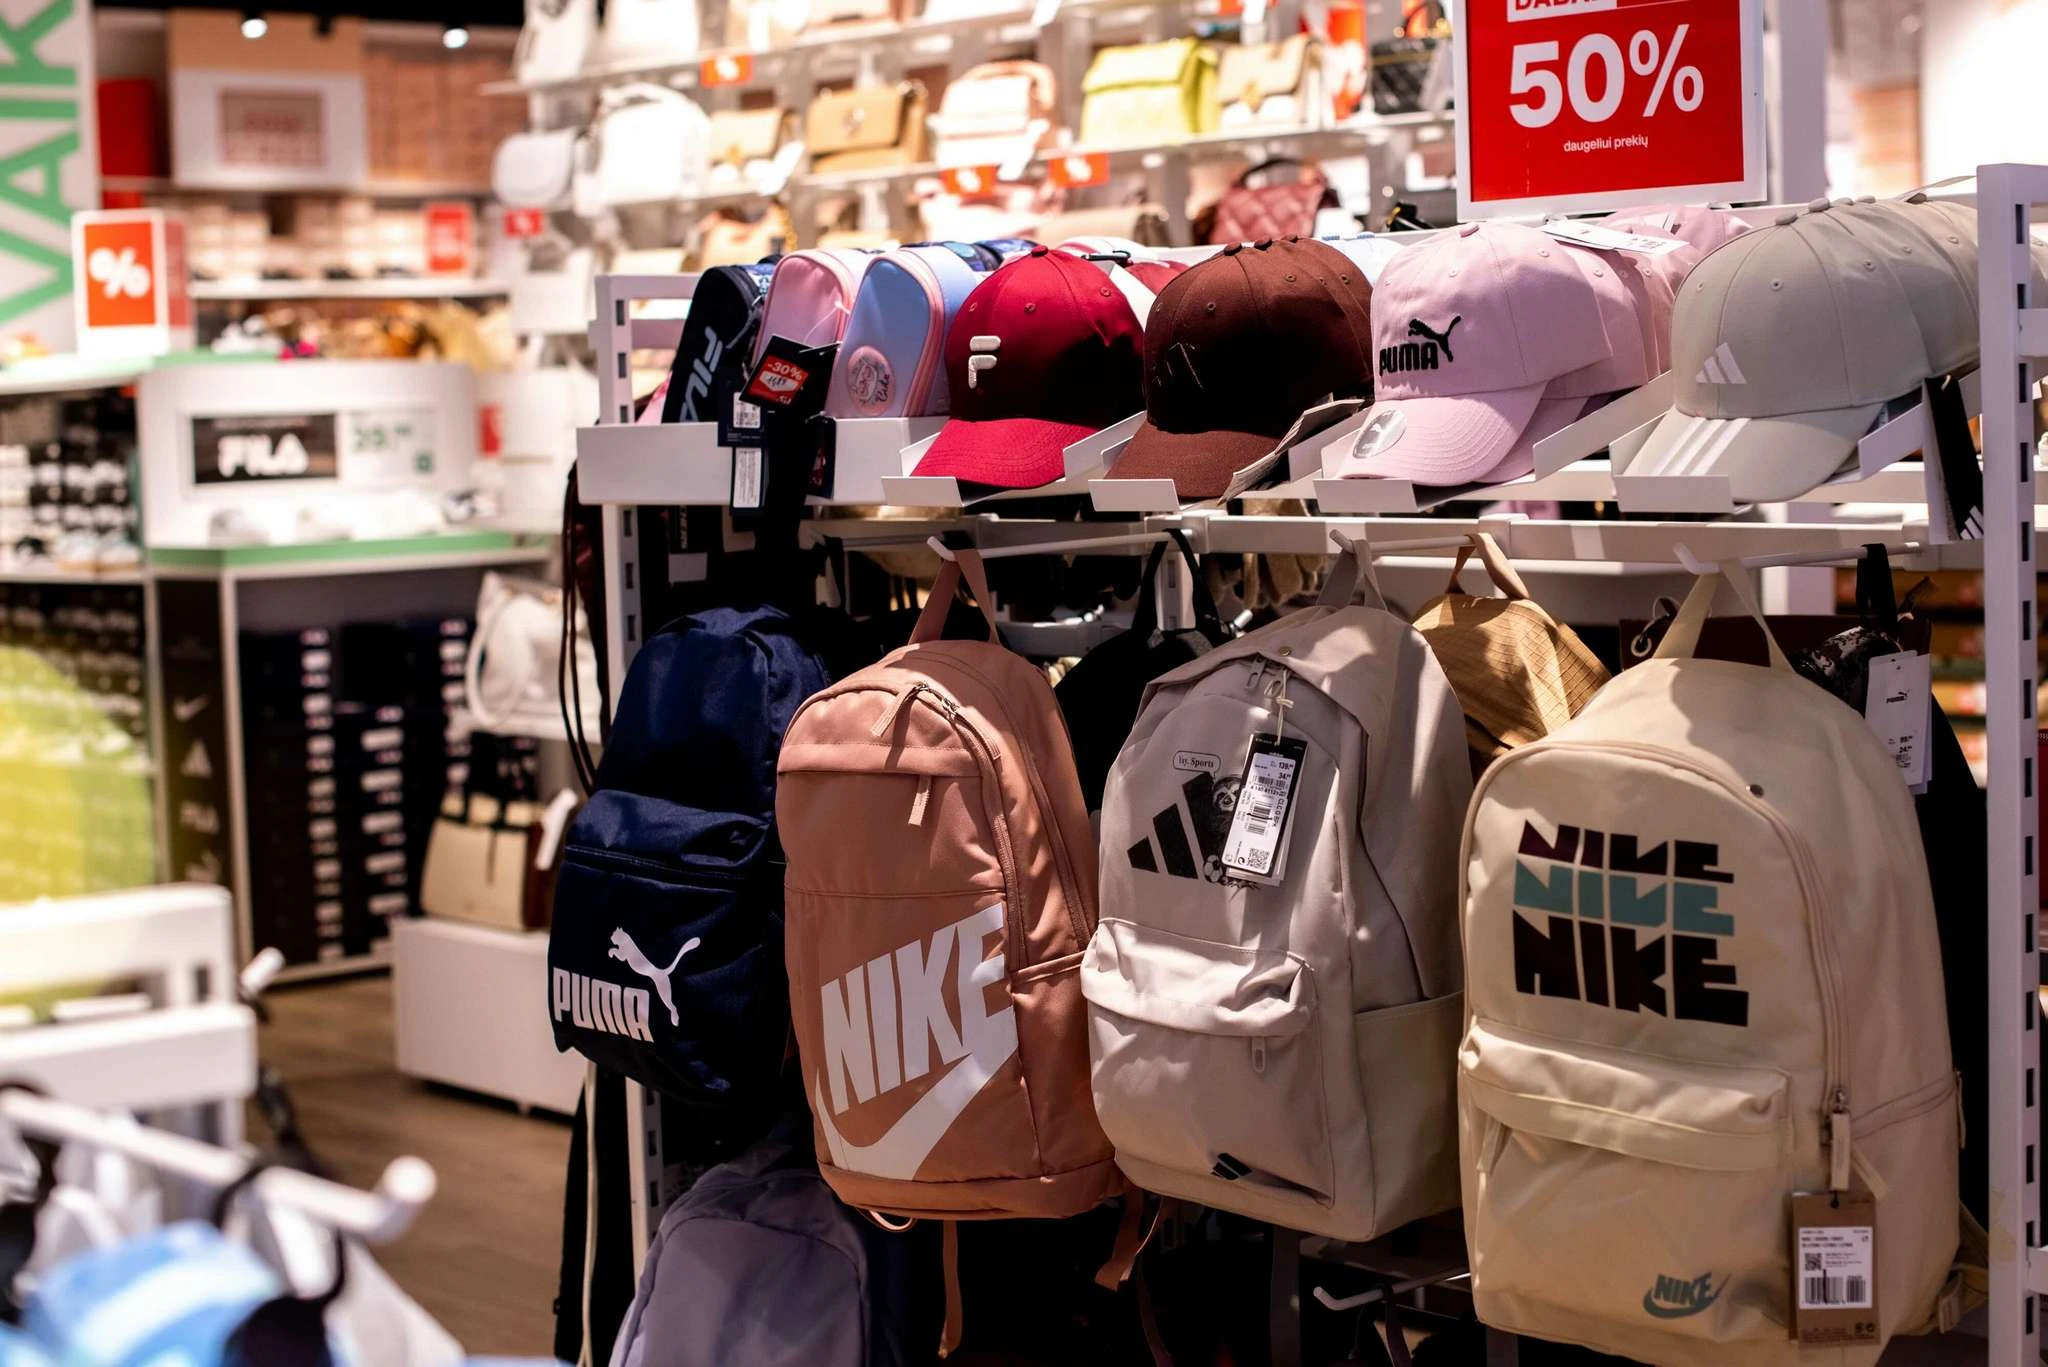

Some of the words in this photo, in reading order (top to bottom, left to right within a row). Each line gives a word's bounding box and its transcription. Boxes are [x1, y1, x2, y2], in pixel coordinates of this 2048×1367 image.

[1509, 24, 1705, 128] 50%
[1564, 137, 1612, 153] daugeliui
[1614, 134, 1649, 150] prekių
[767, 361, 803, 381] -30%
[1379, 342, 1439, 377] PUMA
[217, 433, 309, 477] FILA
[1518, 820, 1734, 884] NIKE
[1514, 858, 1735, 937] NIKE
[1512, 909, 1749, 1027] NIKE
[553, 966, 655, 1043] PUMA
[821, 902, 1019, 1116] NIKE
[1654, 1271, 1712, 1308] NIKE
